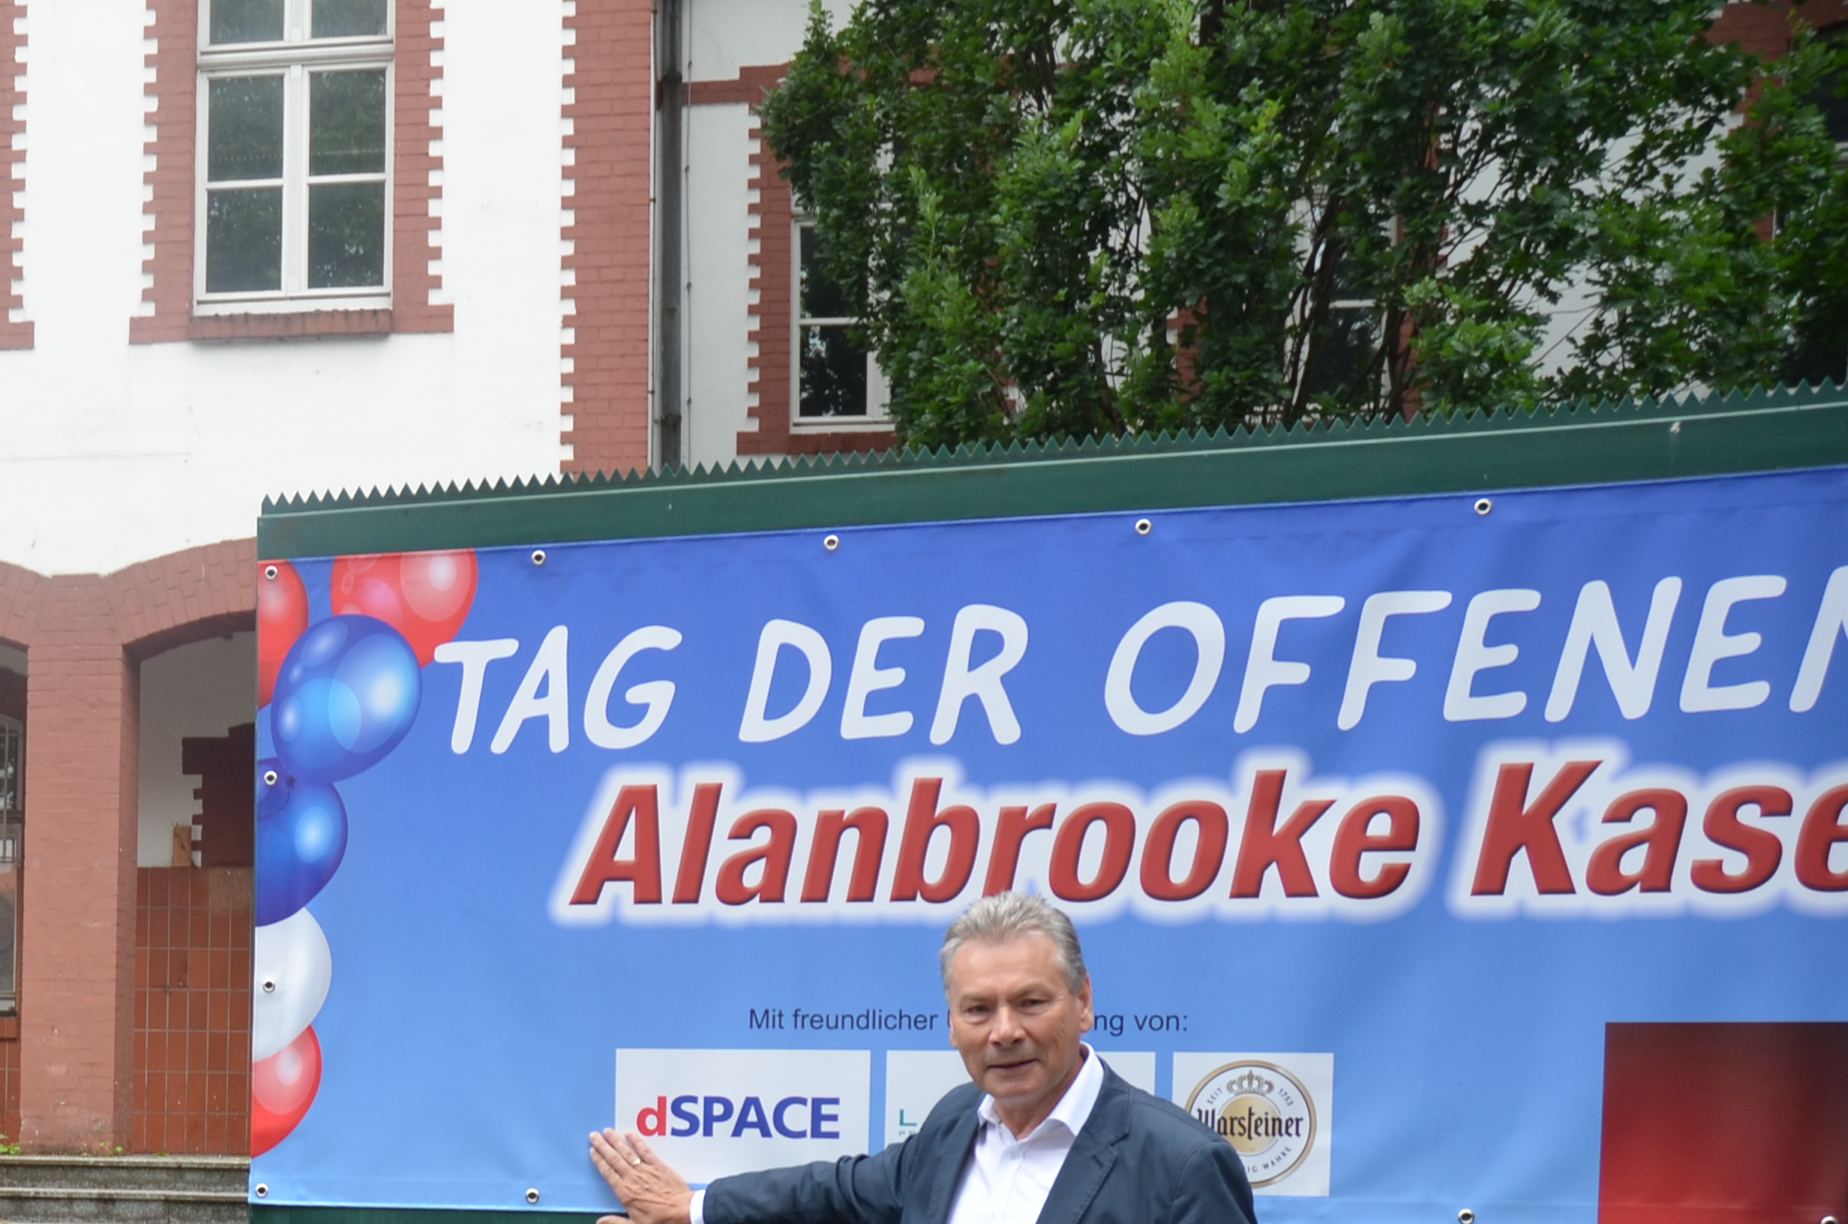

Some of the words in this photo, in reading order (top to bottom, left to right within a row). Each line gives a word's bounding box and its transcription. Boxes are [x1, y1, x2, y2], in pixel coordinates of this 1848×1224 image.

[434, 625, 684, 755] TAG
[739, 604, 1029, 745] DER
[569, 777, 1421, 904] Alanbrooke
[749, 1008, 785, 1030] Mit
[792, 1008, 939, 1030] freundlicher
[1134, 1013, 1188, 1032] von:
[1206, 1087, 1224, 1105] SEIT
[1277, 1088, 1295, 1107] 1753
[636, 1094, 841, 1140] dSPACE
